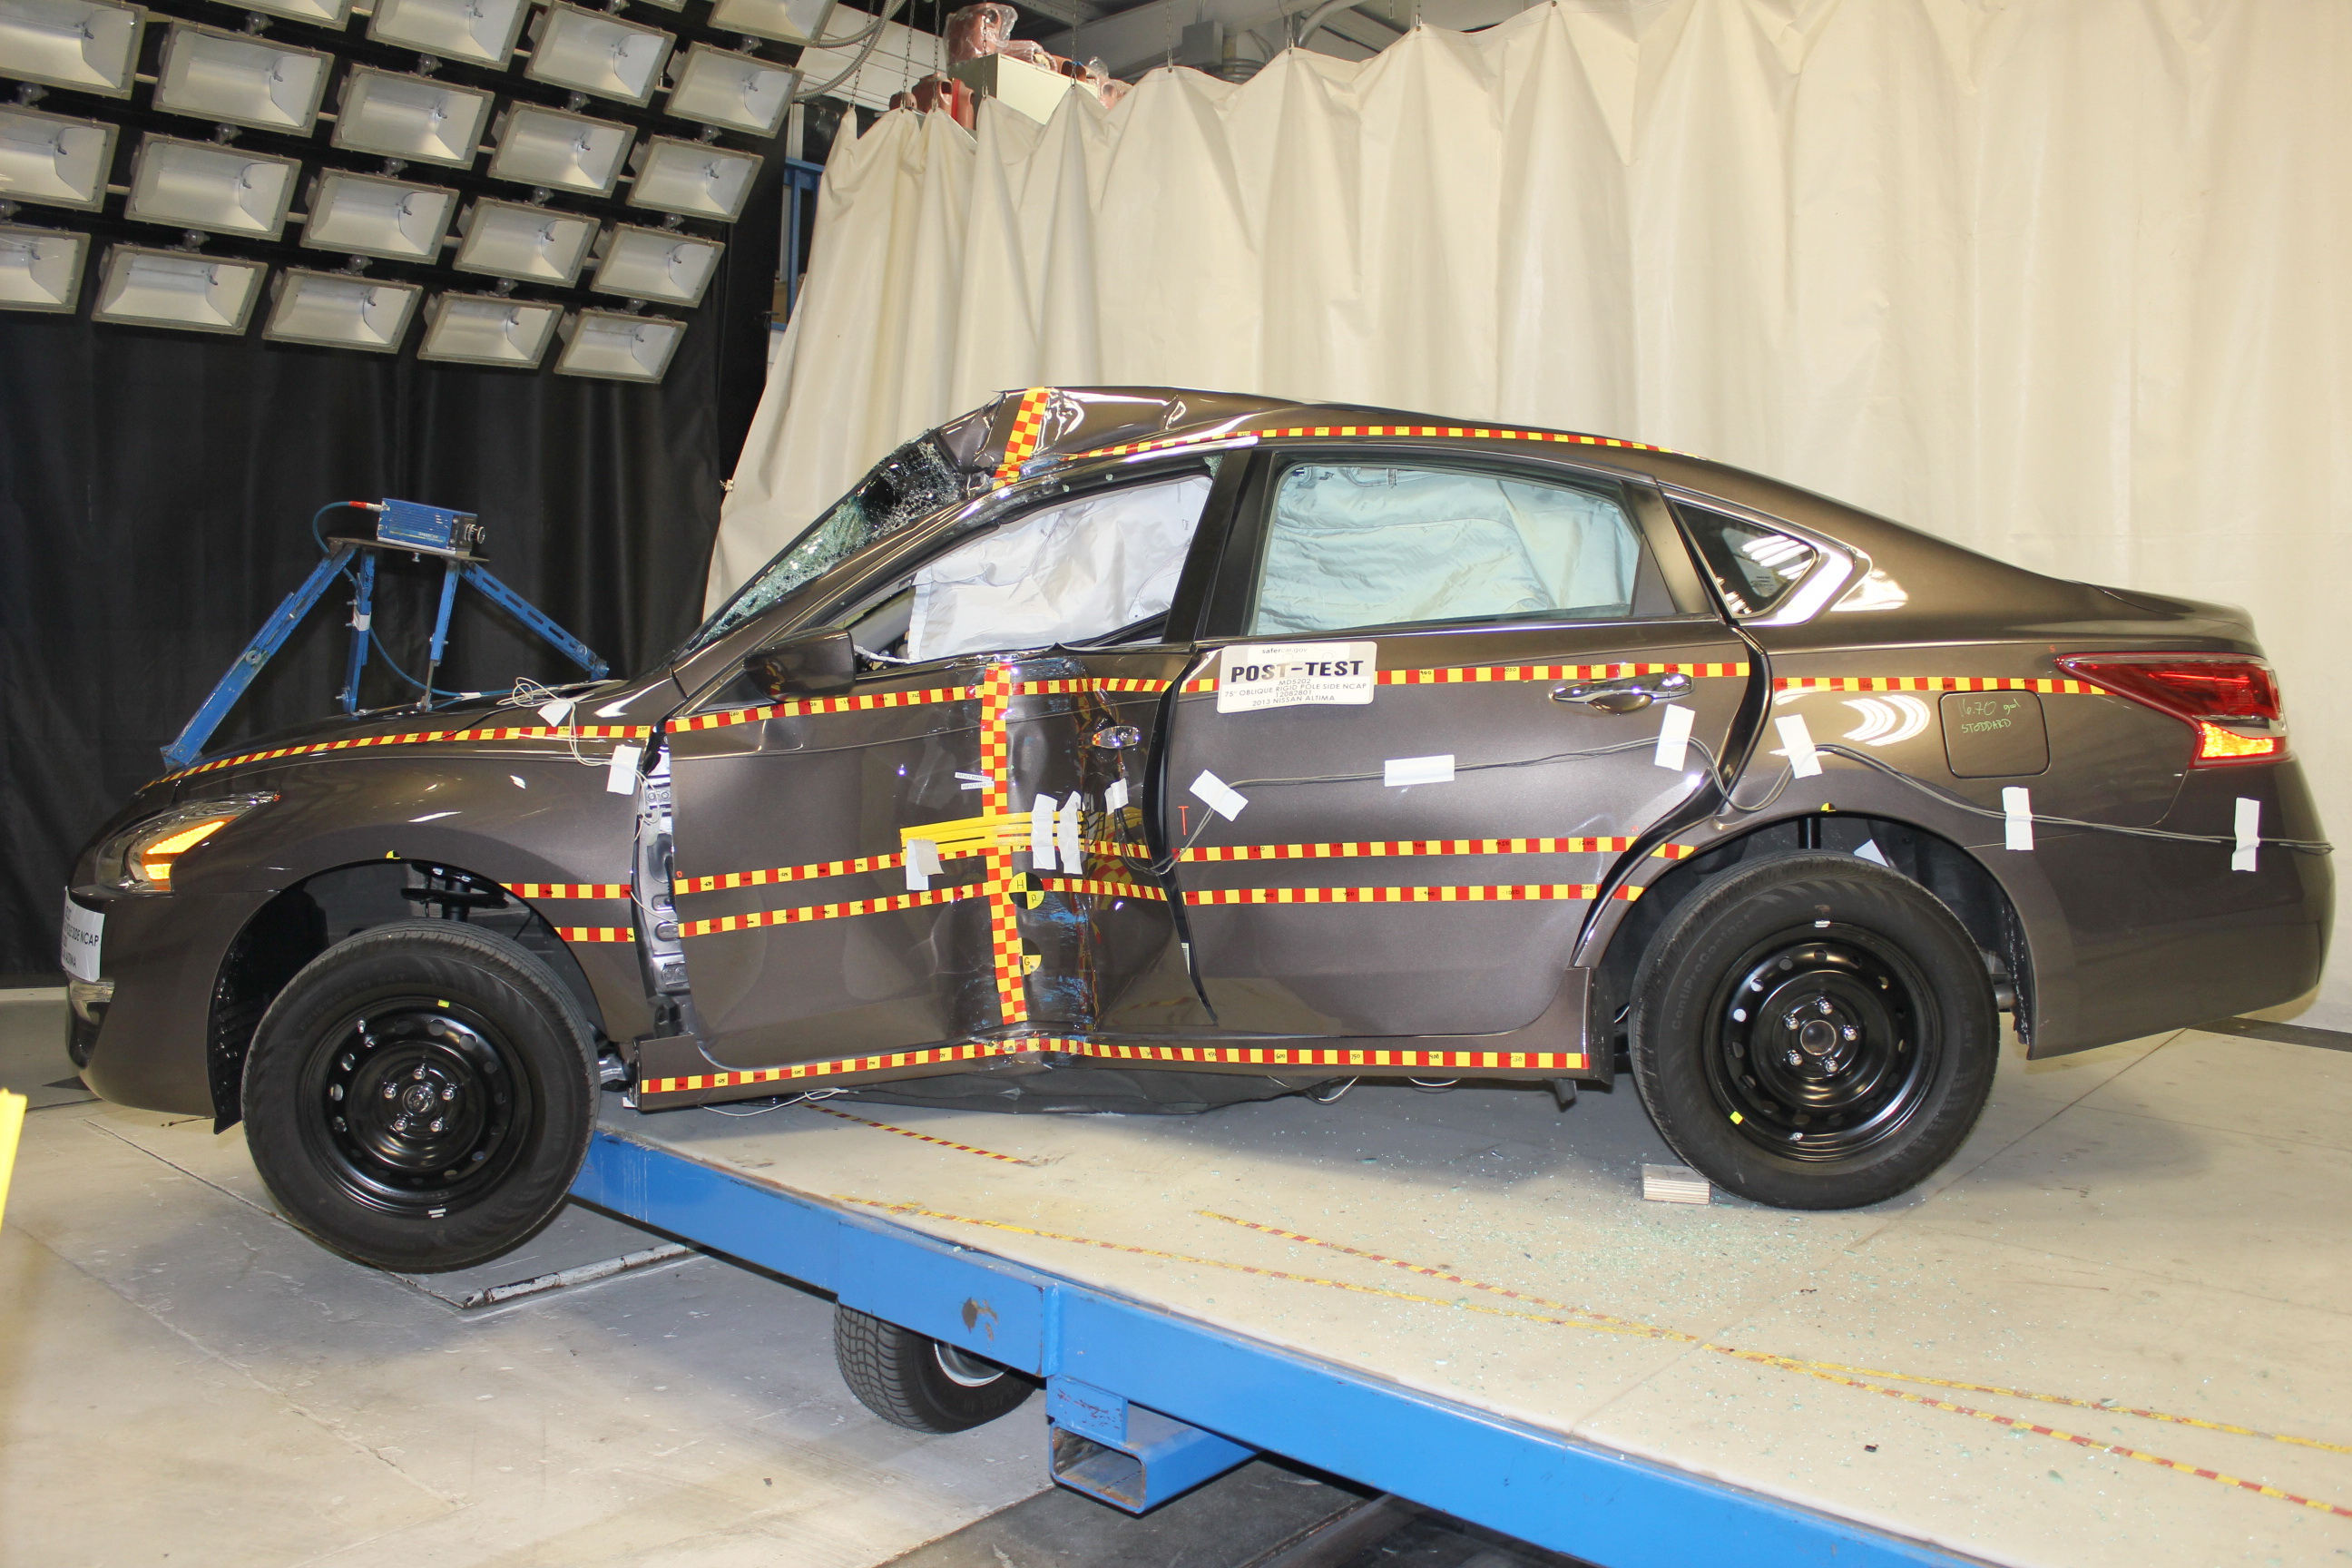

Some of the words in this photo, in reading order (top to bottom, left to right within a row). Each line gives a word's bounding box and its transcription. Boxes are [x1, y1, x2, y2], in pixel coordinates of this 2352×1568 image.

[1230, 660, 1364, 683] POST-TEST
[1279, 678, 1311, 686] MD5202
[1239, 688, 1273, 696] OBLIQUE
[1961, 718, 2012, 734] STODDARD
[1016, 878, 1024, 890] H
[80, 931, 99, 946] NCAP
[1024, 956, 1031, 966] G
